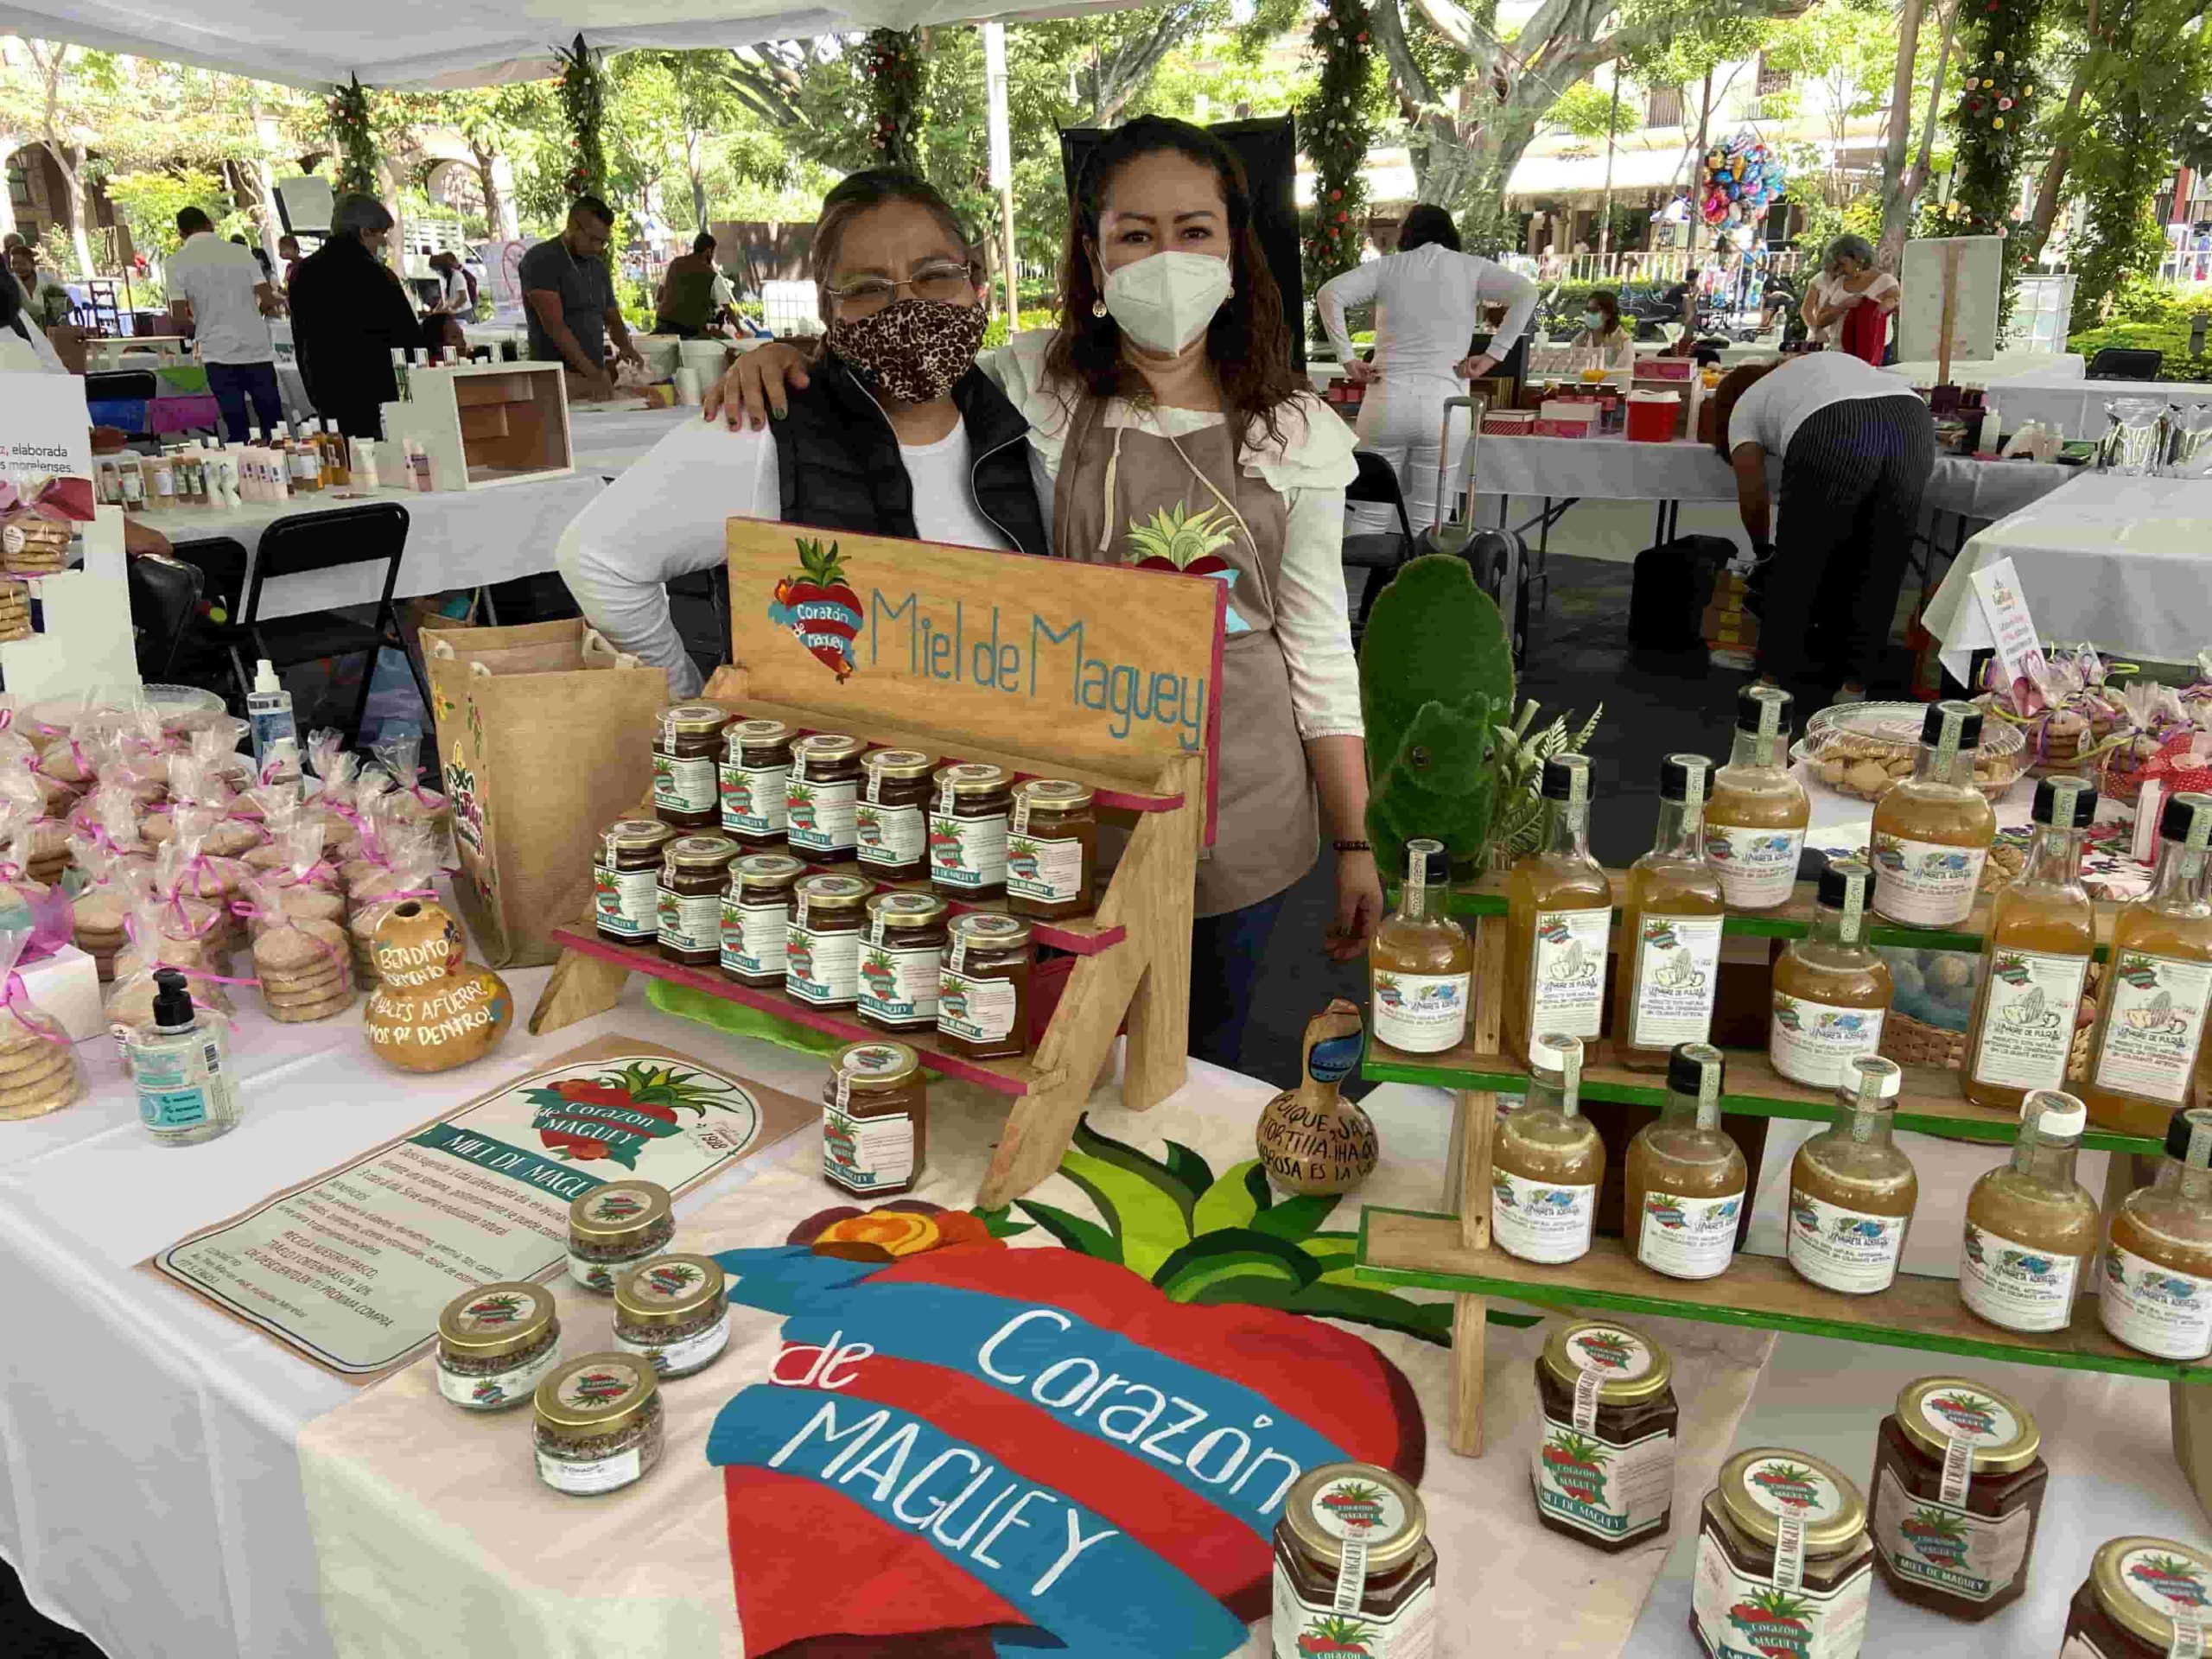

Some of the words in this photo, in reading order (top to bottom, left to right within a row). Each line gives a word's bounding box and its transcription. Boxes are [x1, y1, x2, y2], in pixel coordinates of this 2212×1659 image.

[12, 442, 67, 457] elaborada
[9, 459, 74, 473] morelenses.
[797, 604, 849, 623] Corazón
[793, 622, 805, 638] de
[871, 588, 962, 682] Miel
[972, 607, 1020, 691] de
[1030, 614, 1205, 750] Maguey
[379, 939, 449, 969] BENDITO
[422, 980, 487, 1021] AFUERA?
[416, 1006, 494, 1046] DENTRO!
[538, 1106, 560, 1118] de
[544, 1117, 639, 1145] MAGUEY
[698, 1132, 728, 1150] 1928
[442, 1135, 496, 1160] MIEL
[488, 1152, 526, 1171] DE
[522, 1161, 596, 1198] MAGU
[1310, 1163, 1325, 1180] ES
[282, 1230, 319, 1248] RECICLA
[313, 1244, 351, 1262] NUESTRO
[344, 1258, 383, 1279] FRASCO,
[255, 1255, 303, 1279] DESCUENTO
[354, 1305, 397, 1327] COMPRA
[352, 1283, 376, 1295] 10%
[768, 1330, 874, 1389] de
[977, 1309, 1300, 1514] Corazón
[768, 1402, 1119, 1596] MAGUEY
[1579, 1505, 1621, 1529] MAGUEY
[1901, 1558, 1922, 1573] MIEL
[1927, 1567, 1937, 1577] DE
[1942, 1572, 1985, 1590] MAGUEY
[1754, 1637, 1800, 1650] MAGUEY
